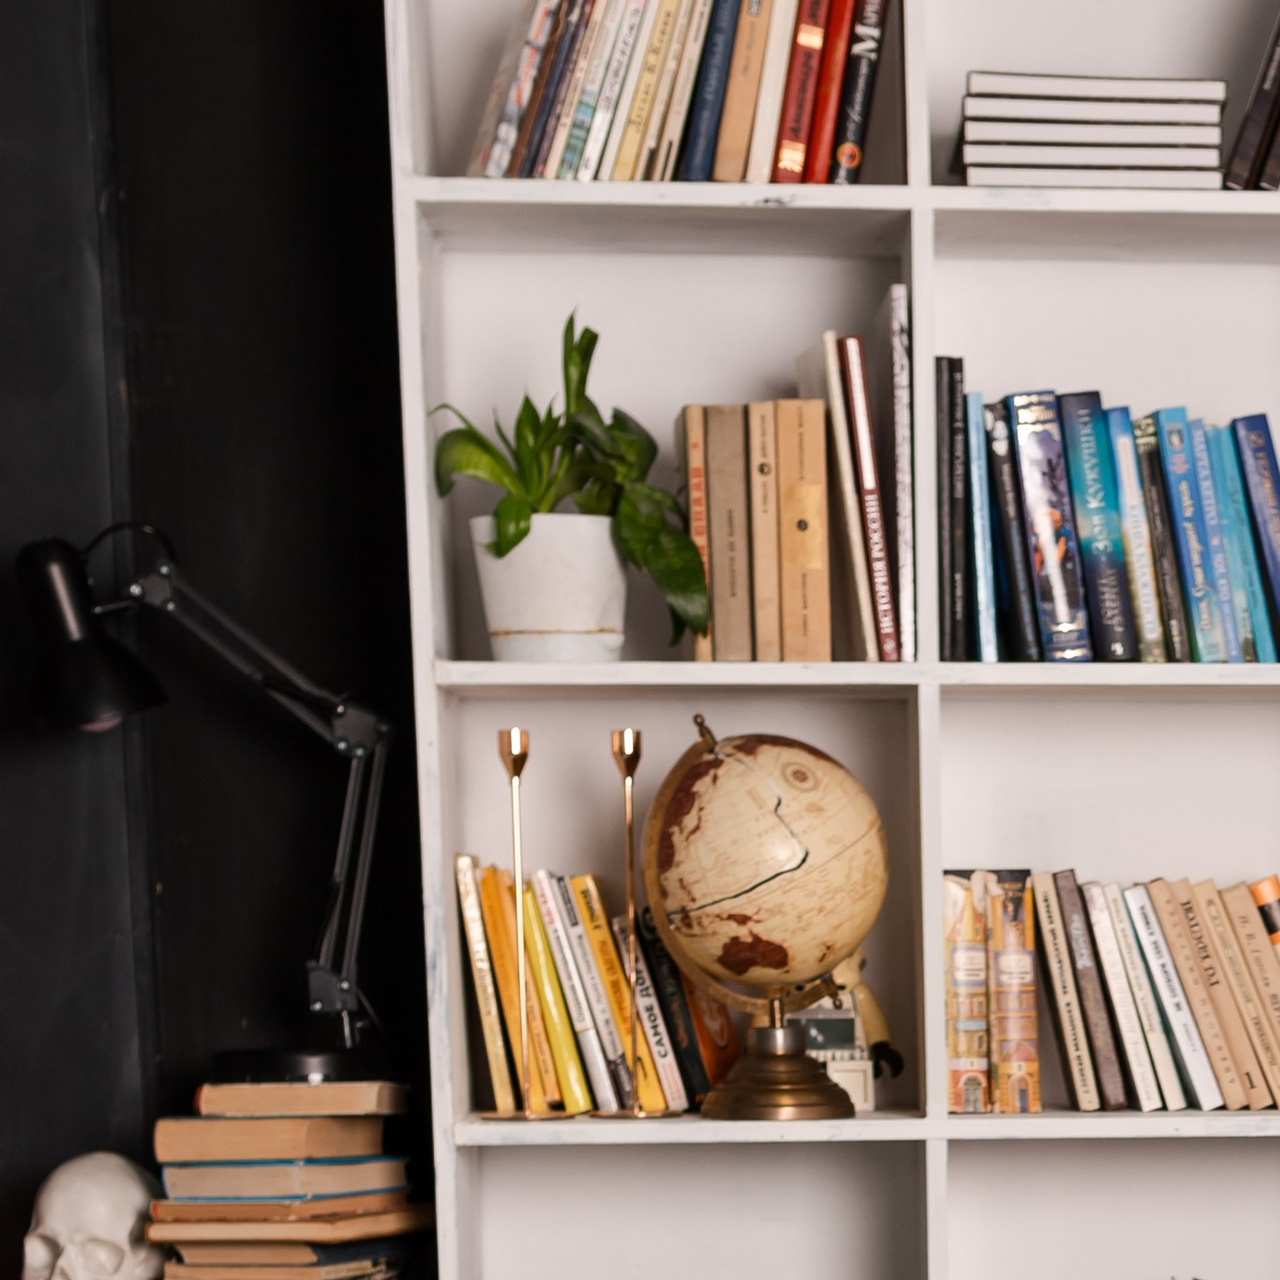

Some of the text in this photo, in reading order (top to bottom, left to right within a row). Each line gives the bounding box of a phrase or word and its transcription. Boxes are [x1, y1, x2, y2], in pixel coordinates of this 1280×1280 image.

[861, 494, 895, 635] ИСТОРИЯ РОССИИ
[641, 1002, 670, 1060] САМОЕ
